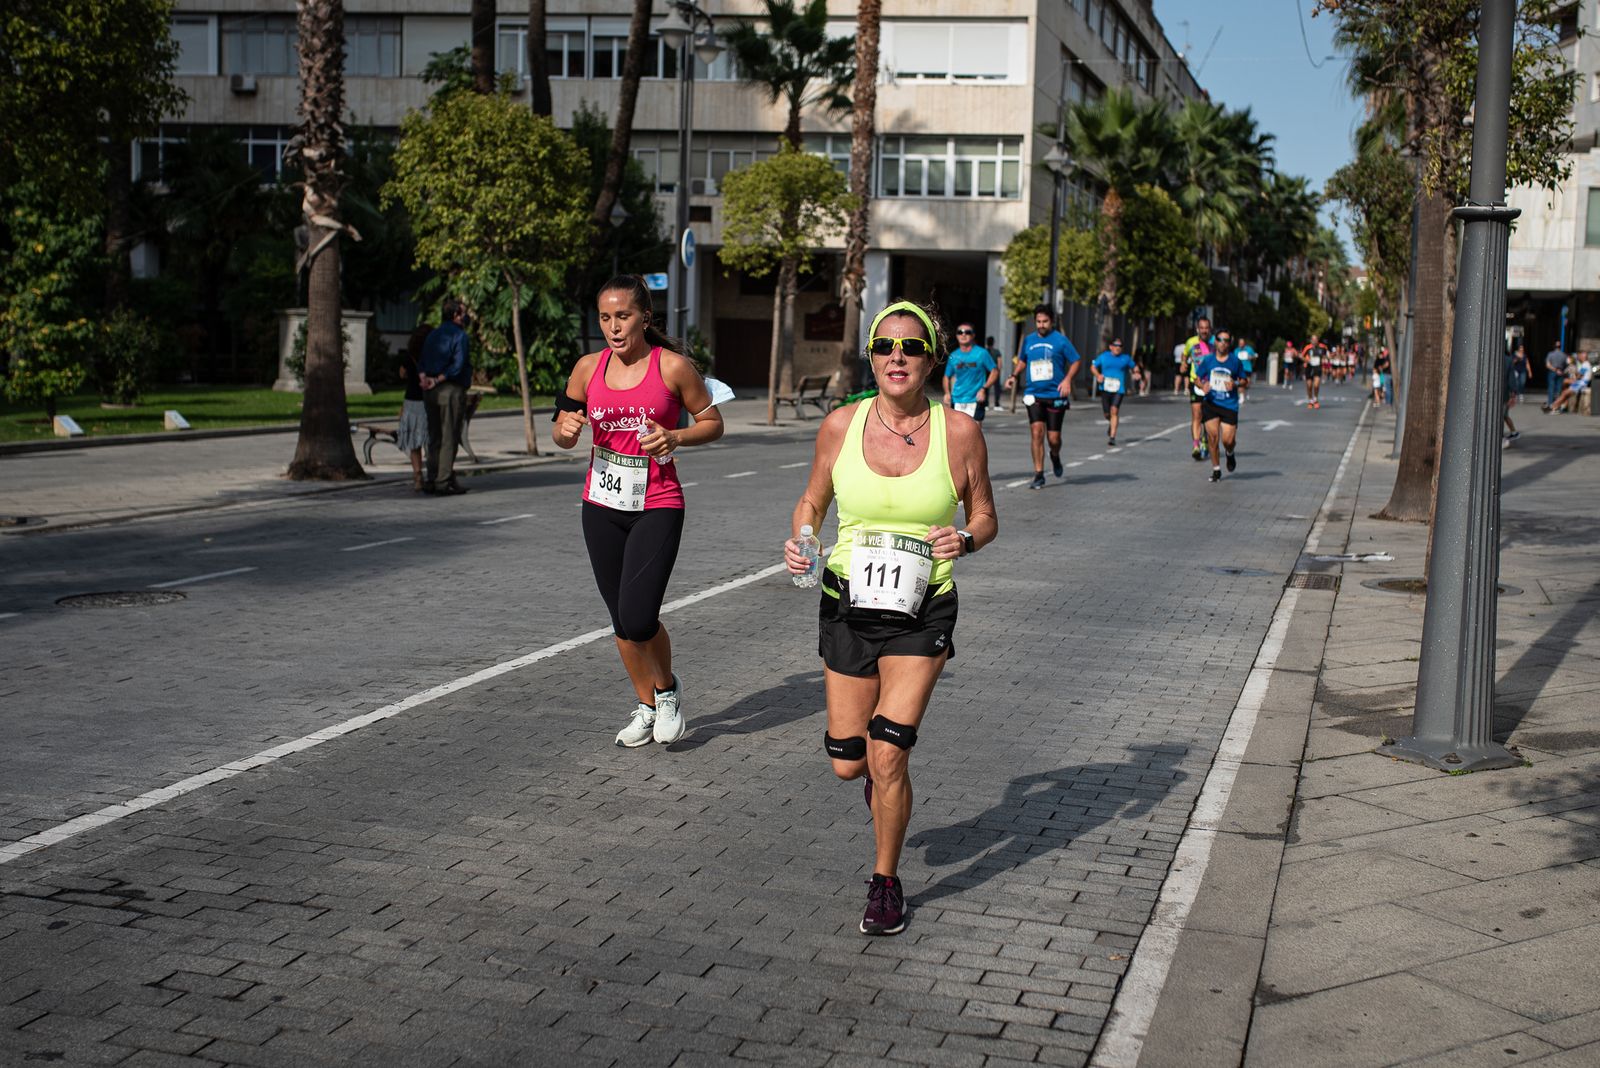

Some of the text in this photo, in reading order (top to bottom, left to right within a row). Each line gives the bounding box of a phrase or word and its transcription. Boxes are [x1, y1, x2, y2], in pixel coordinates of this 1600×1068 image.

[607, 407, 656, 415] HYROX
[599, 413, 647, 432] Queen
[617, 456, 621, 465] A
[621, 457, 643, 467] HUELVA
[599, 471, 622, 494] 384
[868, 535, 896, 548] VUELA
[897, 538, 903, 549] A
[904, 540, 930, 557] HUELVA
[864, 562, 902, 589] 111
